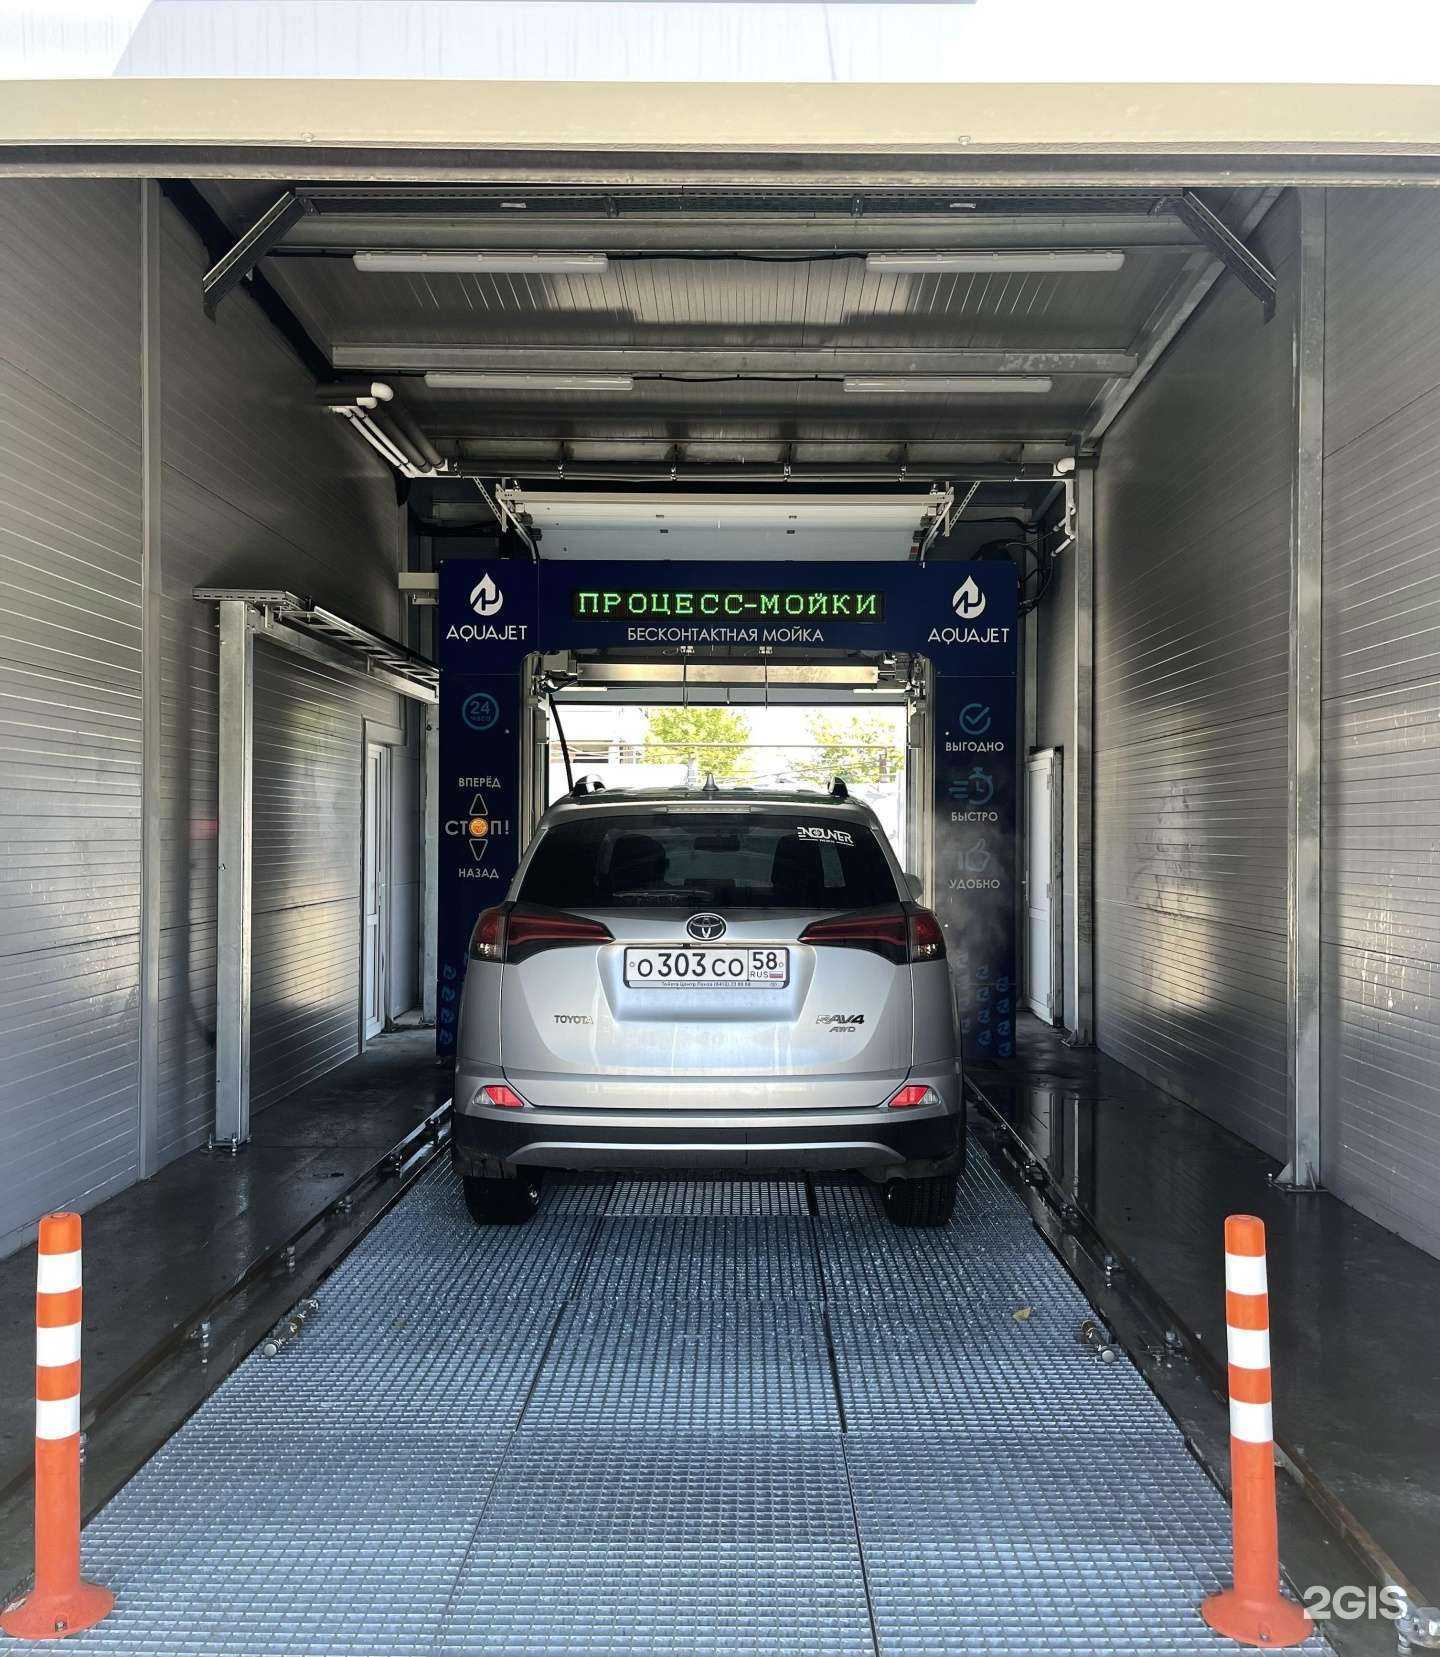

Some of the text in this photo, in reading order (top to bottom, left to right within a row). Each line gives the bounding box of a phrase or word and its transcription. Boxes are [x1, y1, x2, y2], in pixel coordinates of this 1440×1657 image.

[579, 592, 877, 615] ПРОЦЕСС-МОЙКИ
[446, 625, 528, 642] AQUAJET
[628, 626, 824, 642] БЕСКОНТАКТНАЯ МОЙКА
[927, 627, 1010, 645] AQUAJET
[470, 700, 490, 715] 24
[945, 741, 1005, 753] ВЫГОДНО
[458, 776, 502, 788] ВПЕРЁД
[951, 811, 998, 822] БЫСТРО
[458, 868, 500, 879] НАЗАД
[948, 879, 1000, 890] УДОБНО
[752, 951, 778, 970] 58
[553, 1014, 594, 1024] TOYOTA
[815, 1014, 865, 1024] RAV4
